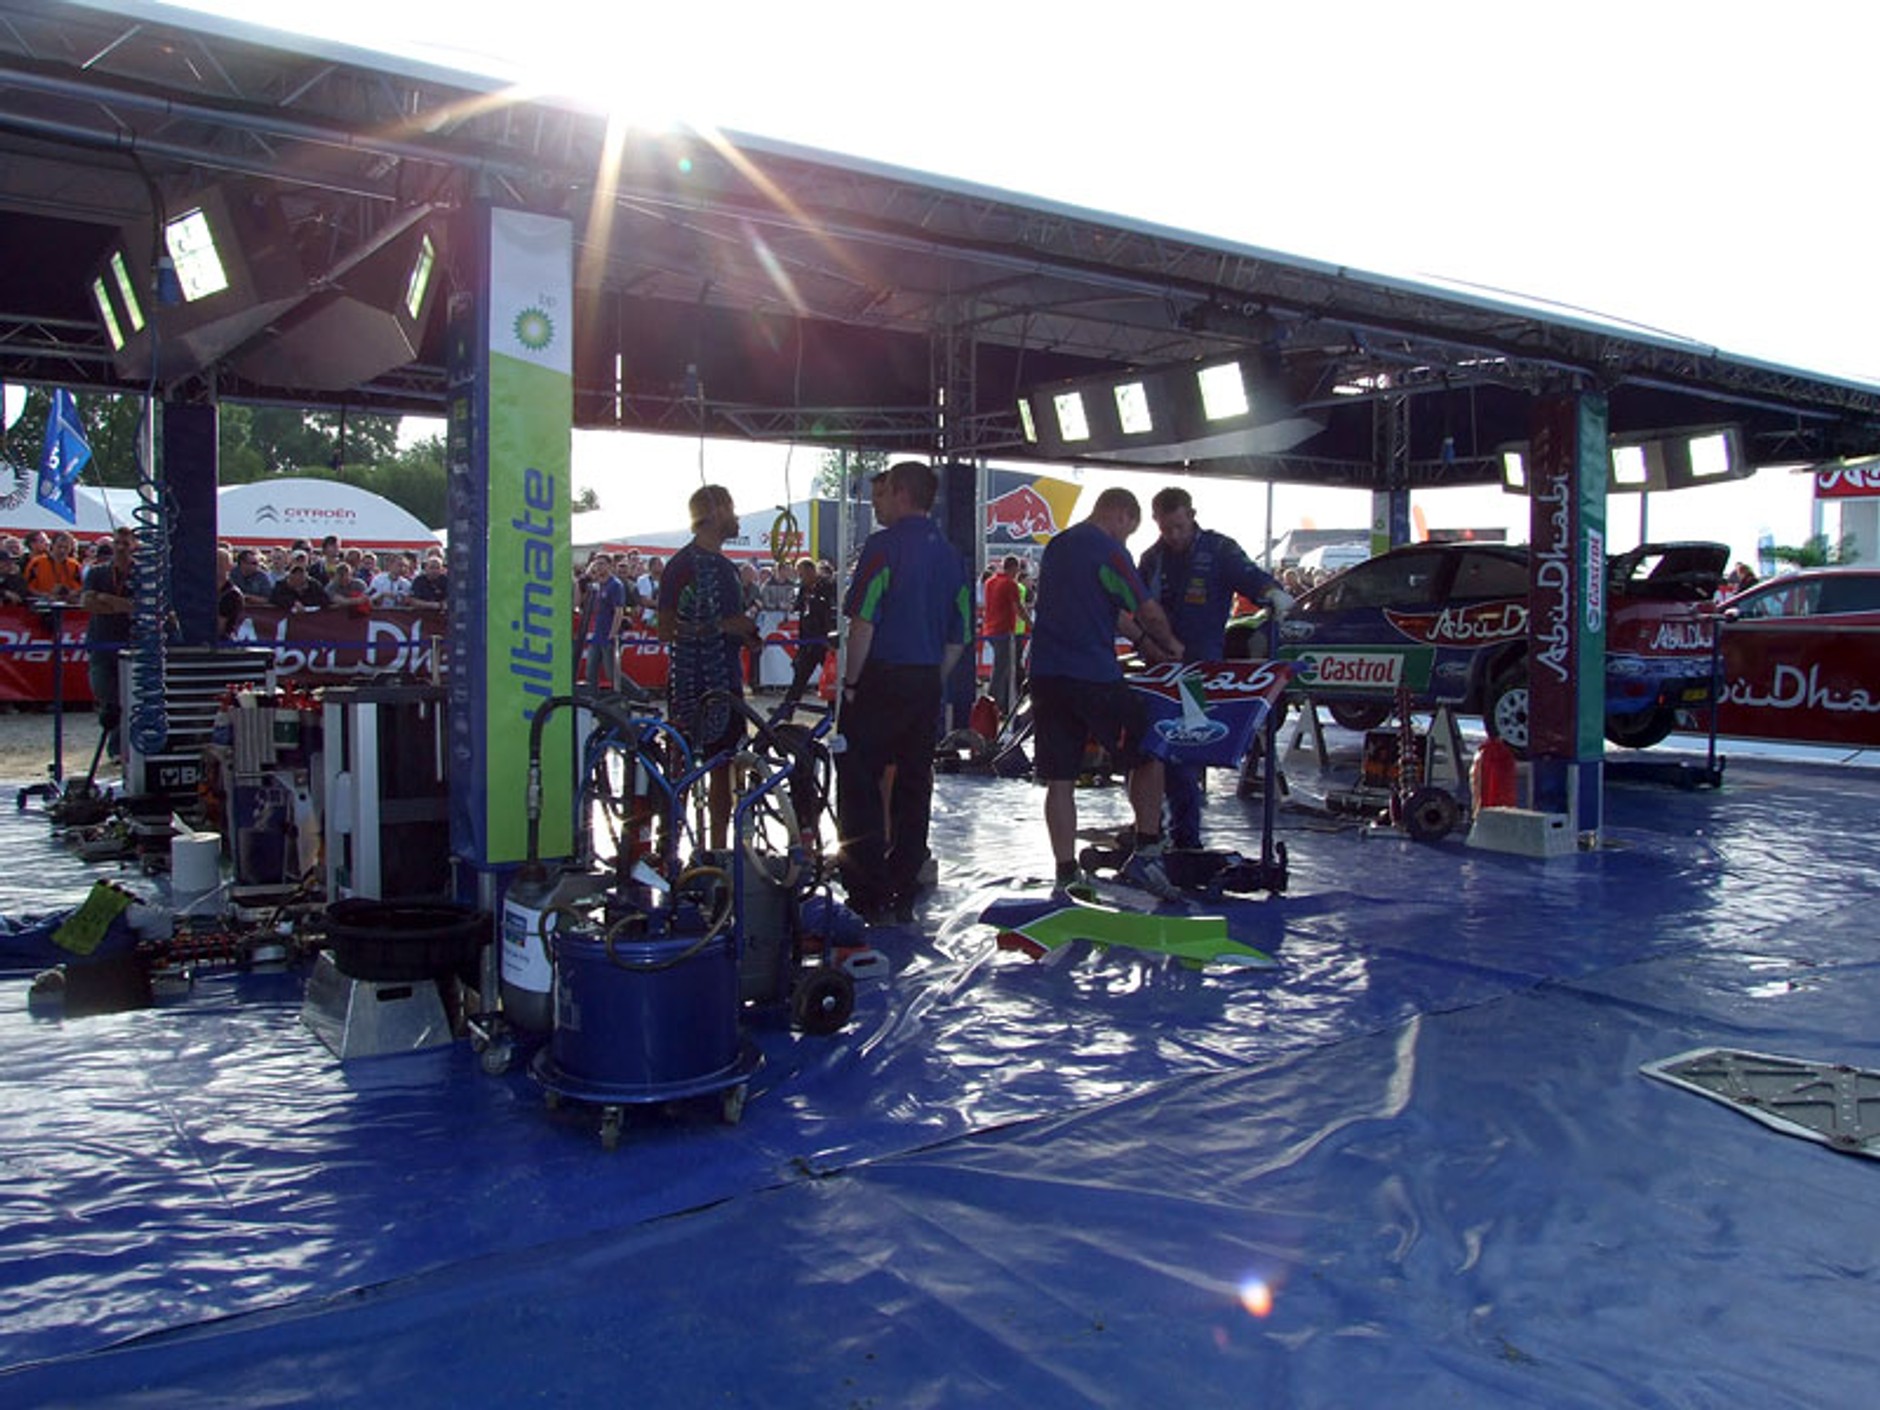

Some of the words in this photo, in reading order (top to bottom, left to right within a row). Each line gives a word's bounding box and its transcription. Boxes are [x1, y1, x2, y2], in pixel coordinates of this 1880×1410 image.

[1537, 472, 1569, 591] Dhabi
[510, 467, 555, 723] ultimate
[1320, 655, 1396, 683] Castrol
